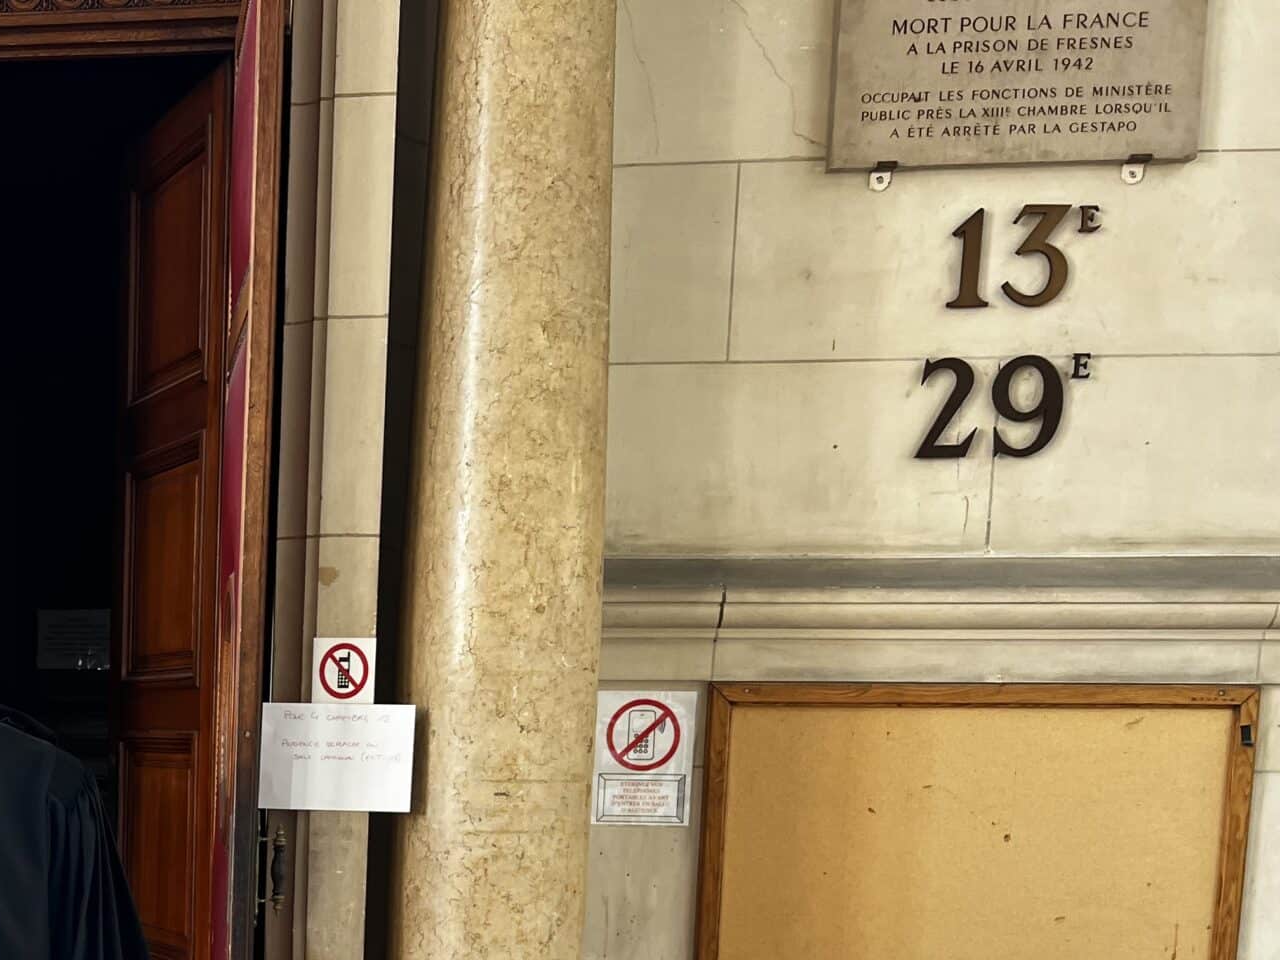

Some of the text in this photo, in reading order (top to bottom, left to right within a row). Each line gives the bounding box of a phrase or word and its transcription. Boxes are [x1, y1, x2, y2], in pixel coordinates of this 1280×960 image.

[892, 11, 1149, 35] MORT POUR LA FRANCE
[907, 36, 1133, 55] A LA PRISON DE FRESNES
[942, 57, 1093, 74] LE 16 AVRIL 1942
[939, 90, 963, 101] LES
[972, 87, 1056, 100] FONCTIONS
[1065, 86, 1083, 98] DE
[861, 110, 910, 121] PUBLIC
[959, 108, 976, 119] LA
[1017, 104, 1087, 117] CHAMBRE
[890, 128, 899, 138] A
[1009, 124, 1036, 135] PAR
[1044, 123, 1061, 134] LA
[1069, 121, 1136, 133] GESTAPO
